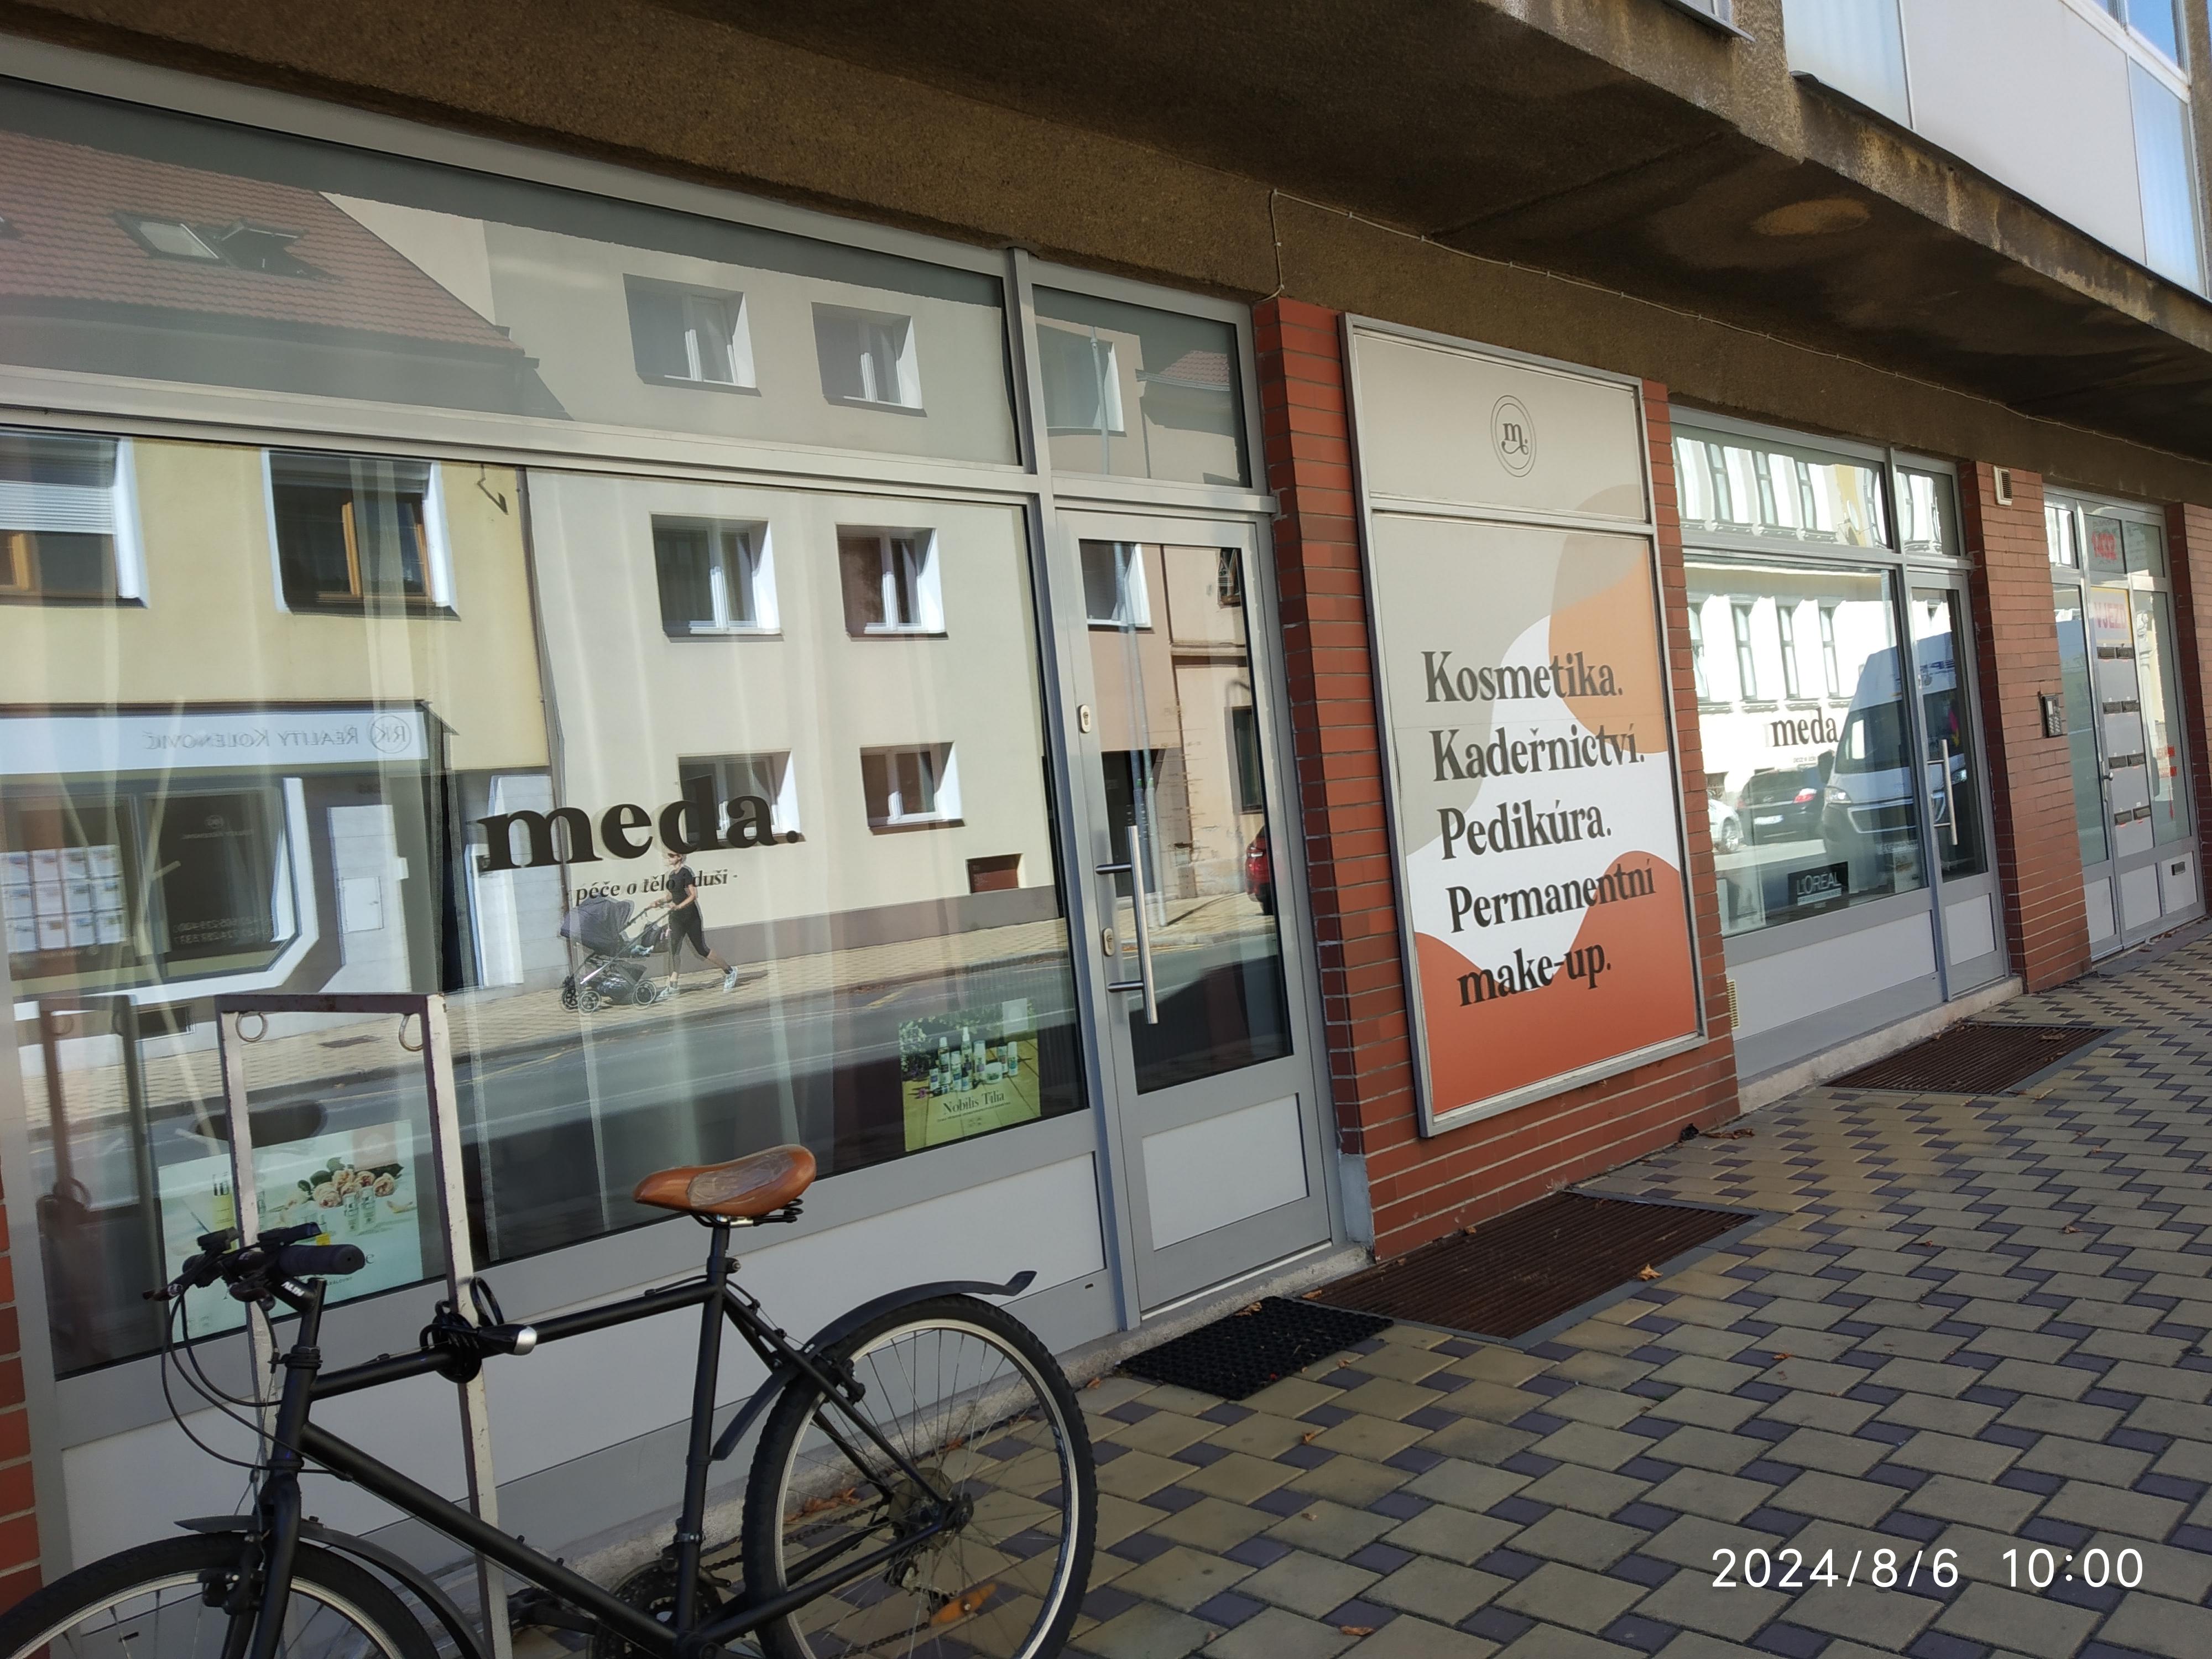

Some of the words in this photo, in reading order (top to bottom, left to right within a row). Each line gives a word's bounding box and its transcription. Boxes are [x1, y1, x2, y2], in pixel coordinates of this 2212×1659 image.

[1421, 650, 1624, 703] Kosmetika.
[1428, 722, 1645, 782] Kadeřnictví.
[476, 778, 799, 872] meda.
[1437, 799, 1611, 860] Pedikúra.
[575, 880, 620, 906] péče
[627, 883, 637, 894] o
[643, 874, 675, 893] tělo
[693, 869, 728, 887] duši
[1445, 858, 1656, 933] Permanentní
[1457, 942, 1612, 1006] make-up.
[943, 1095, 979, 1114] Nobilis
[981, 1089, 1005, 1104] Tilia
